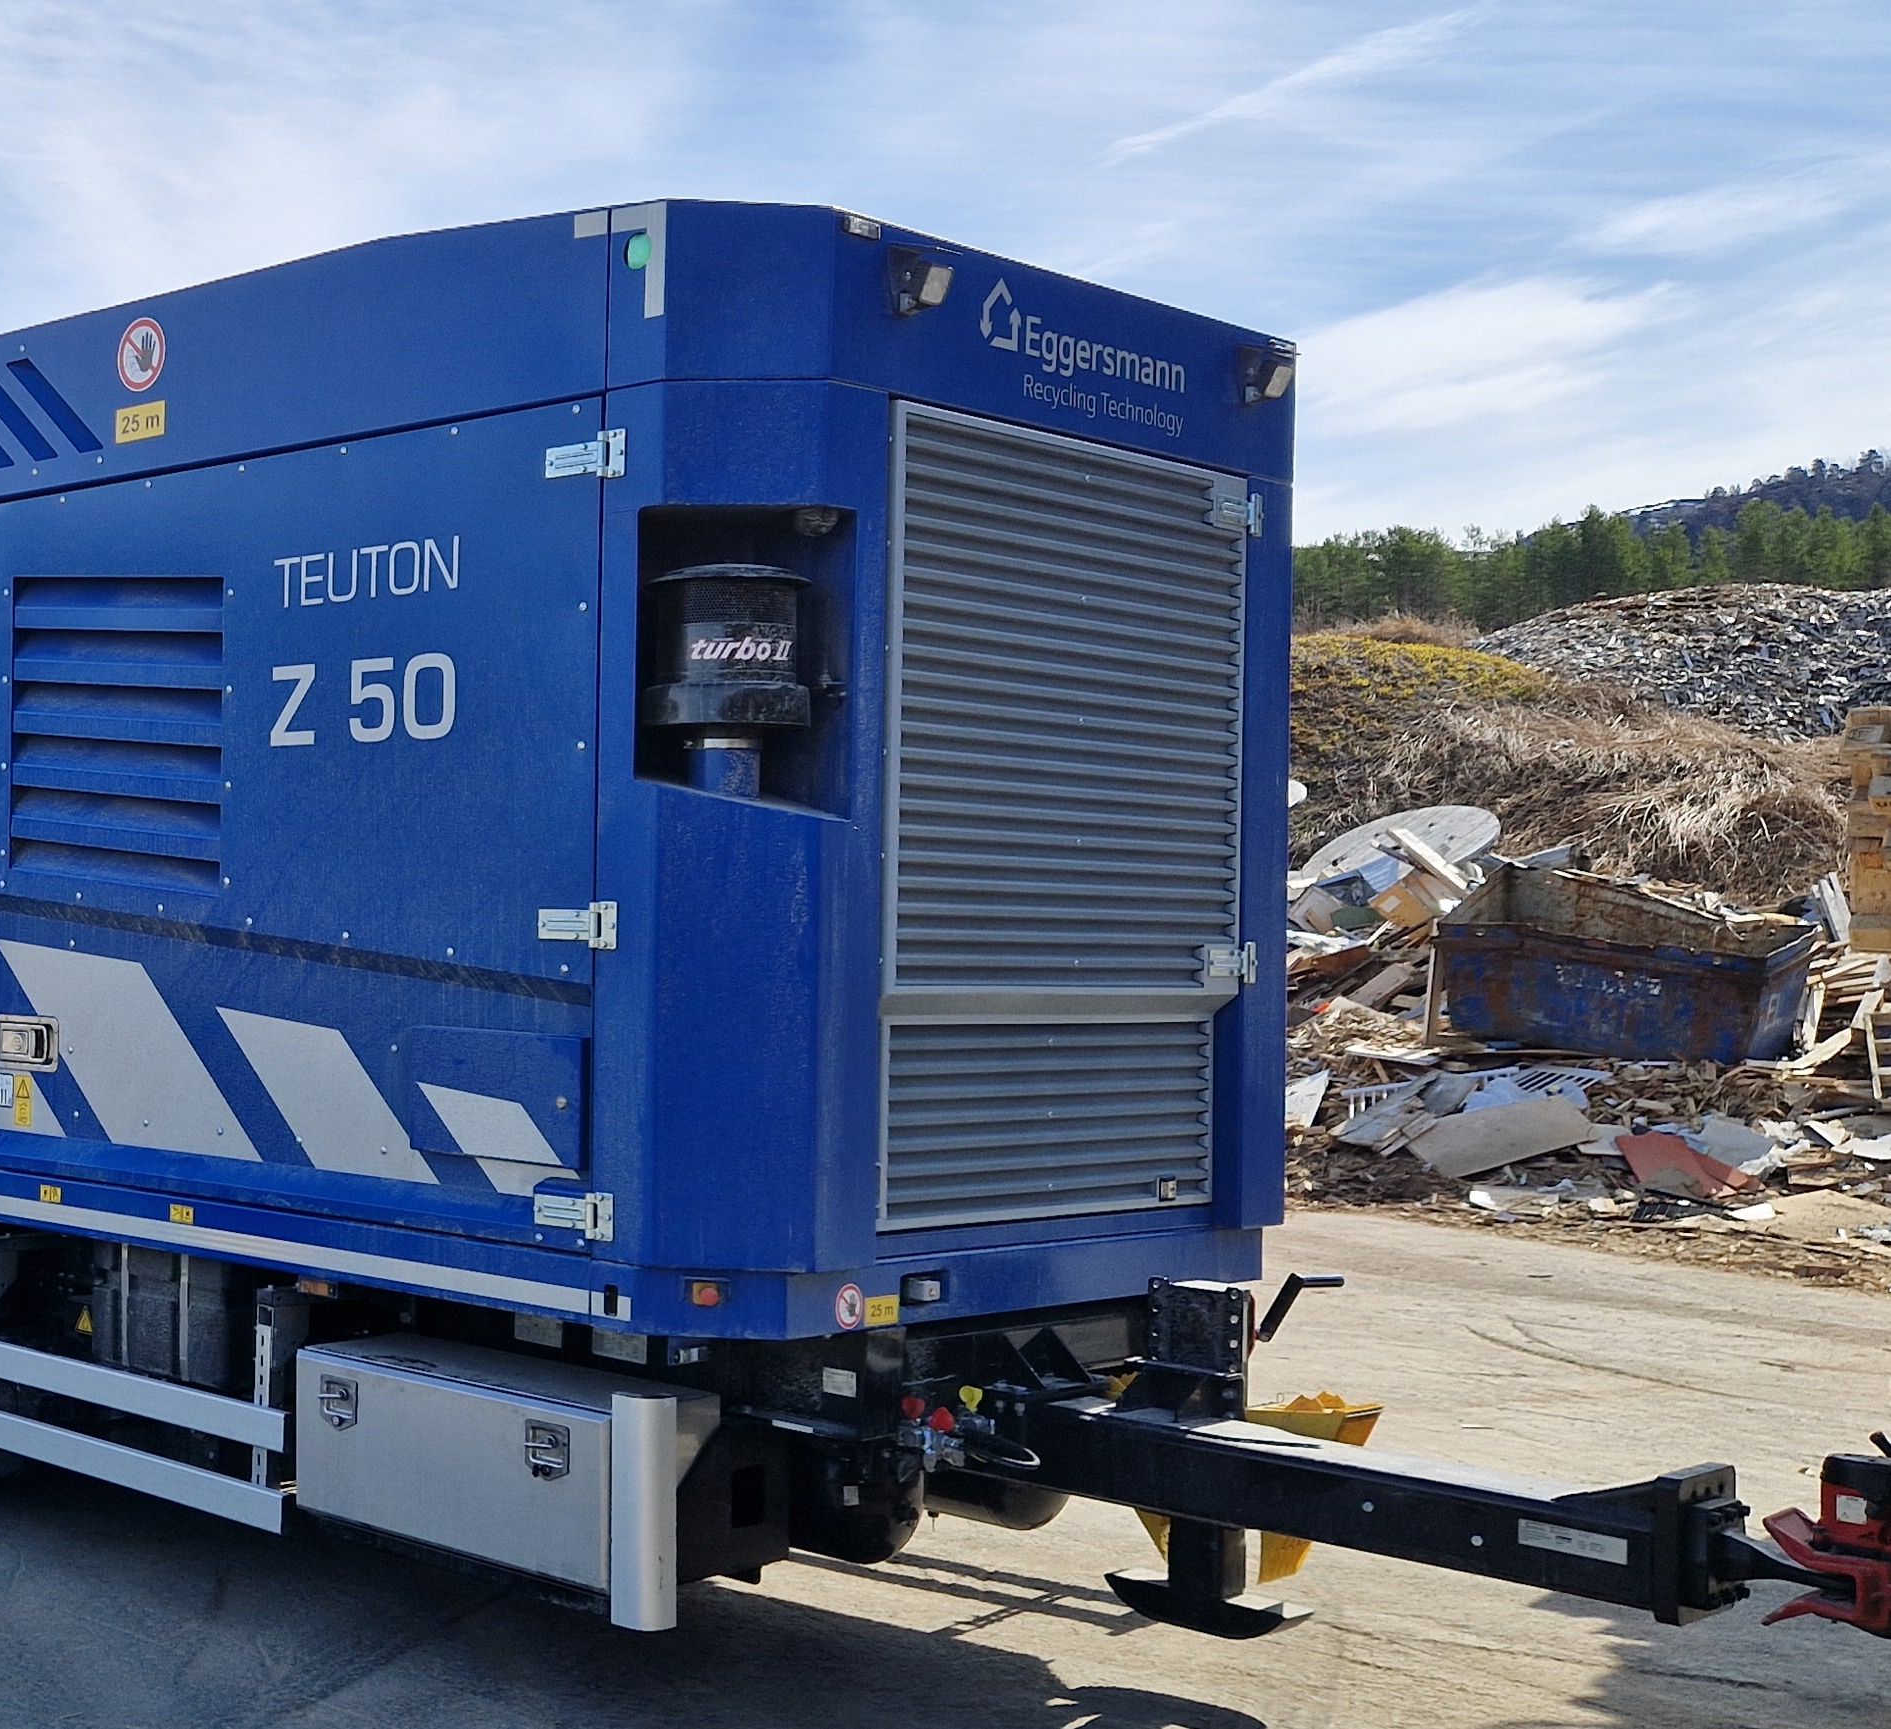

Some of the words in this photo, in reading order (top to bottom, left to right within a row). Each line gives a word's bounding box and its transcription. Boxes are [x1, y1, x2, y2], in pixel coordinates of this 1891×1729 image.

[1024, 315, 1186, 394] Eggersmann
[121, 413, 140, 435] 25
[145, 414, 160, 430] m
[1022, 373, 1097, 419] Recycling
[1100, 391, 1185, 438] Technology
[273, 535, 460, 609] TEUTON
[690, 636, 772, 661] turbo
[772, 640, 793, 661] II
[269, 663, 316, 747] Z
[348, 652, 456, 743] 50
[870, 1304, 882, 1318] 25
[883, 1304, 894, 1317] m
